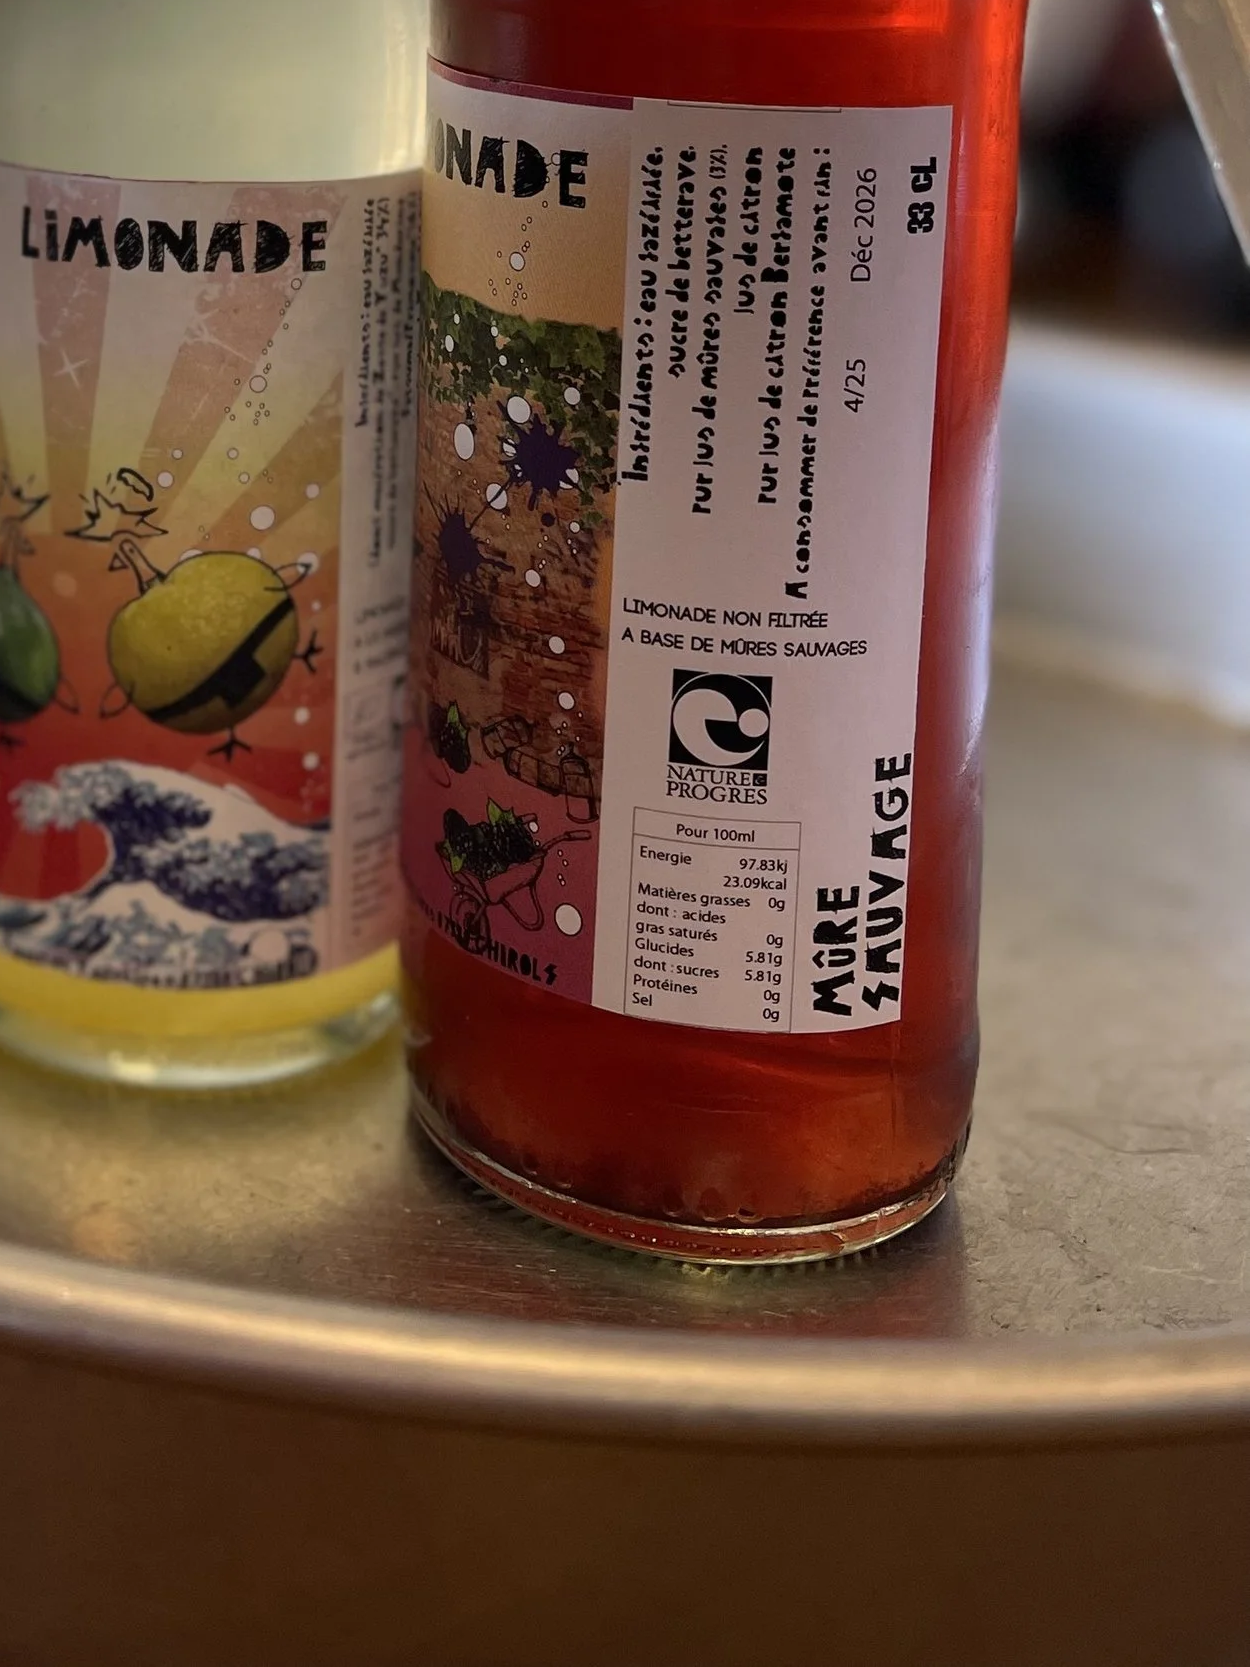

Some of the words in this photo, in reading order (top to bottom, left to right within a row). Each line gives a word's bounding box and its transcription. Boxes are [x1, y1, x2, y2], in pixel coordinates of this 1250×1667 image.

[740, 147, 763, 235] citron
[813, 161, 832, 197] fin
[854, 168, 877, 228] 2026
[760, 148, 796, 283] Bergamote
[907, 201, 935, 235] 33
[811, 203, 830, 274] avant
[733, 242, 758, 266] de
[850, 235, 873, 282] Déc
[640, 270, 657, 313] eau
[665, 278, 690, 302] de
[733, 274, 756, 315] jus
[668, 310, 689, 379] sucre
[765, 291, 788, 378] citron
[696, 312, 721, 390] mûres
[758, 385, 783, 409] de
[844, 358, 866, 413] 4/25
[692, 395, 718, 420] de
[796, 404, 818, 427] de
[693, 427, 716, 467] jus
[759, 416, 781, 456] jus
[796, 434, 817, 573] consommer
[785, 581, 808, 600] A
[623, 597, 716, 624] LIMONADE
[723, 610, 762, 627] NON
[768, 610, 828, 628] FILTRÉE
[621, 627, 634, 642] A
[640, 630, 684, 649] BASE
[691, 636, 714, 653] DE
[721, 638, 777, 656] MÛRES
[784, 640, 867, 657] SAUVAGES
[667, 764, 751, 786] NATURE
[666, 780, 768, 804] PROGRES
[676, 823, 708, 839] Pour
[714, 828, 755, 842] 100ml
[640, 845, 692, 866] Energie
[638, 882, 697, 903] Matières
[700, 894, 751, 908] grasses
[768, 897, 785, 912] 0g
[723, 875, 787, 890] 23.09kcal
[861, 752, 912, 1012] SAUVAGE
[637, 901, 669, 917] dont
[682, 909, 726, 924] acides
[635, 921, 664, 936] gras
[668, 924, 718, 942] saturés
[766, 934, 783, 949] 0g
[635, 938, 695, 958] Glucides
[745, 951, 783, 967] 5.81g
[634, 956, 667, 972] dont
[744, 969, 782, 985] 5.81g
[633, 974, 698, 995] Protéines
[763, 990, 780, 1004] 0g
[632, 992, 653, 1007] Sel
[762, 1008, 780, 1022] 0g
